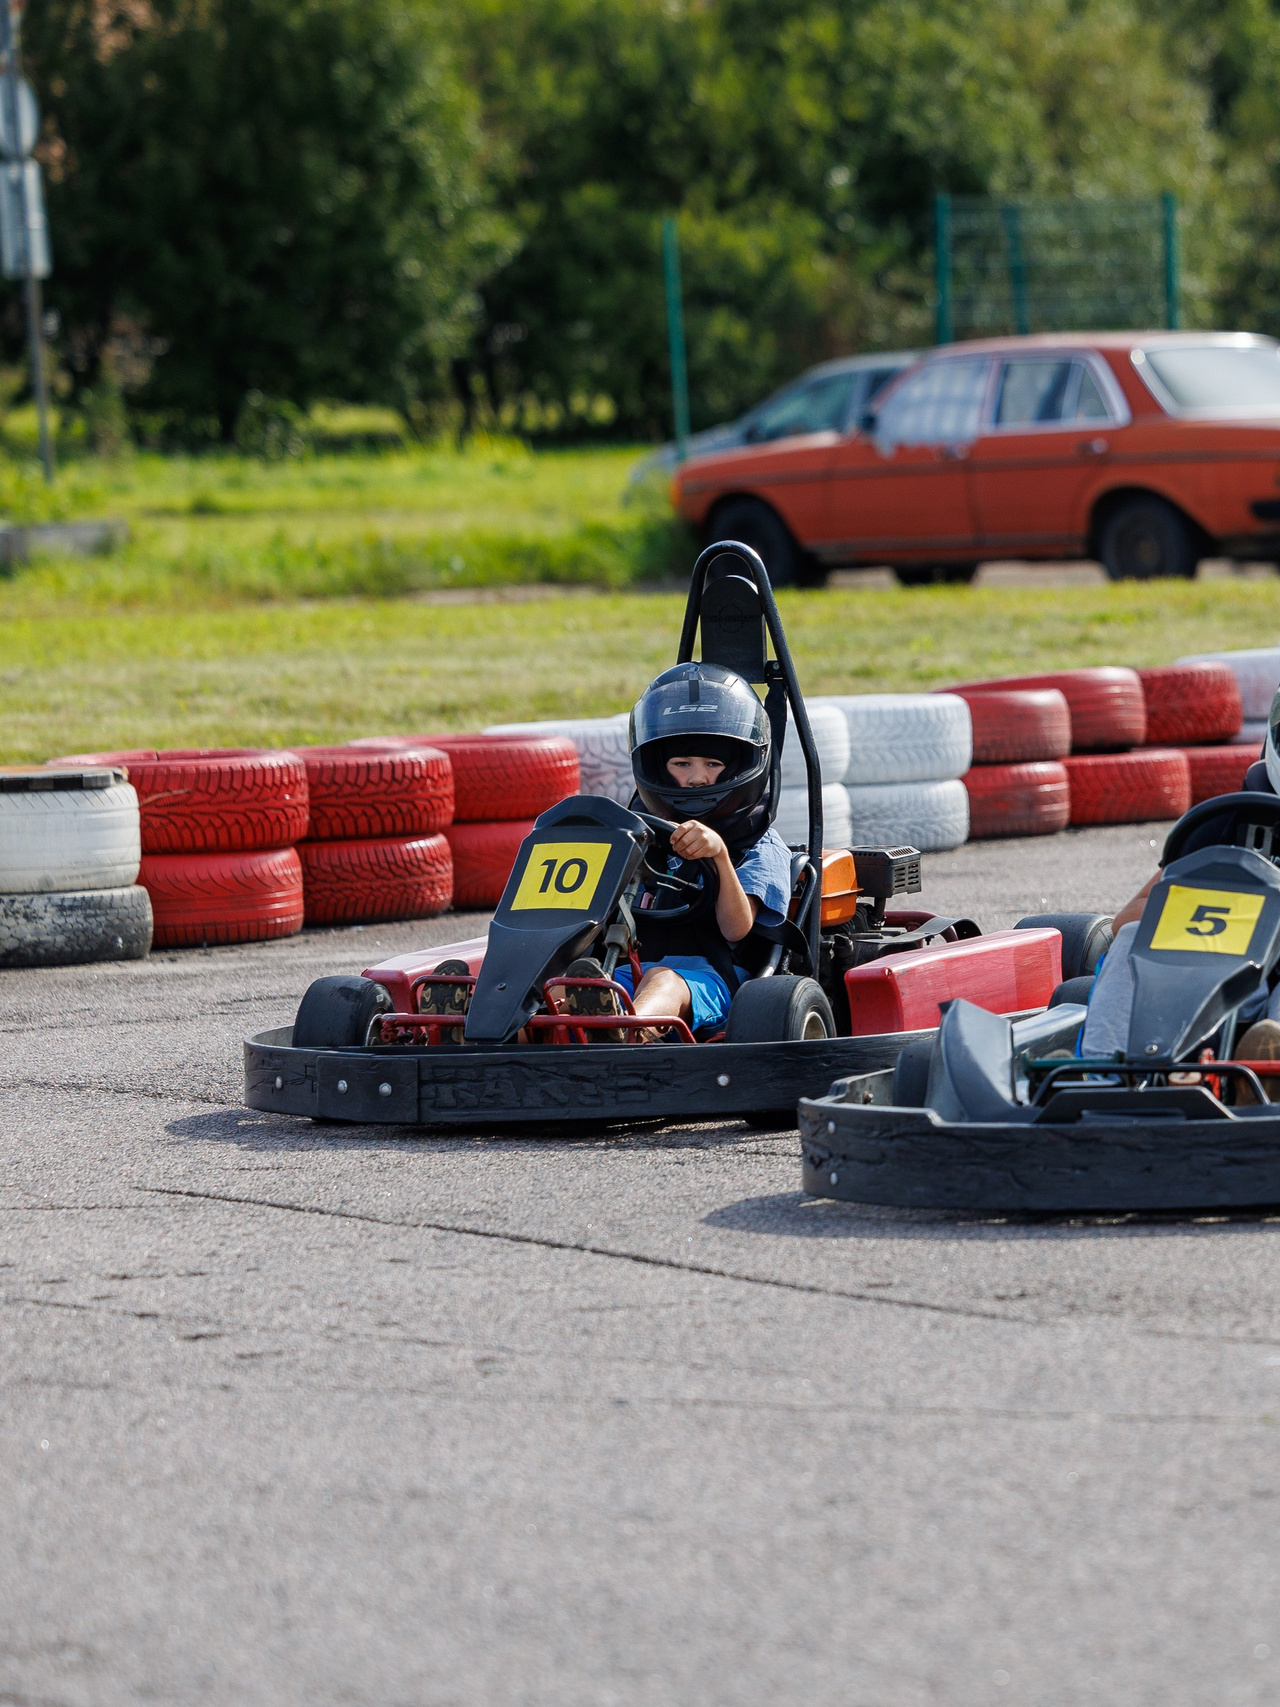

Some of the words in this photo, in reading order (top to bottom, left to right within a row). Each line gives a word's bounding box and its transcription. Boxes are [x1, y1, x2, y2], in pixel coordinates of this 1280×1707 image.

[663, 704, 718, 716] LS2
[538, 858, 588, 894] 10
[1185, 905, 1231, 936] 5
